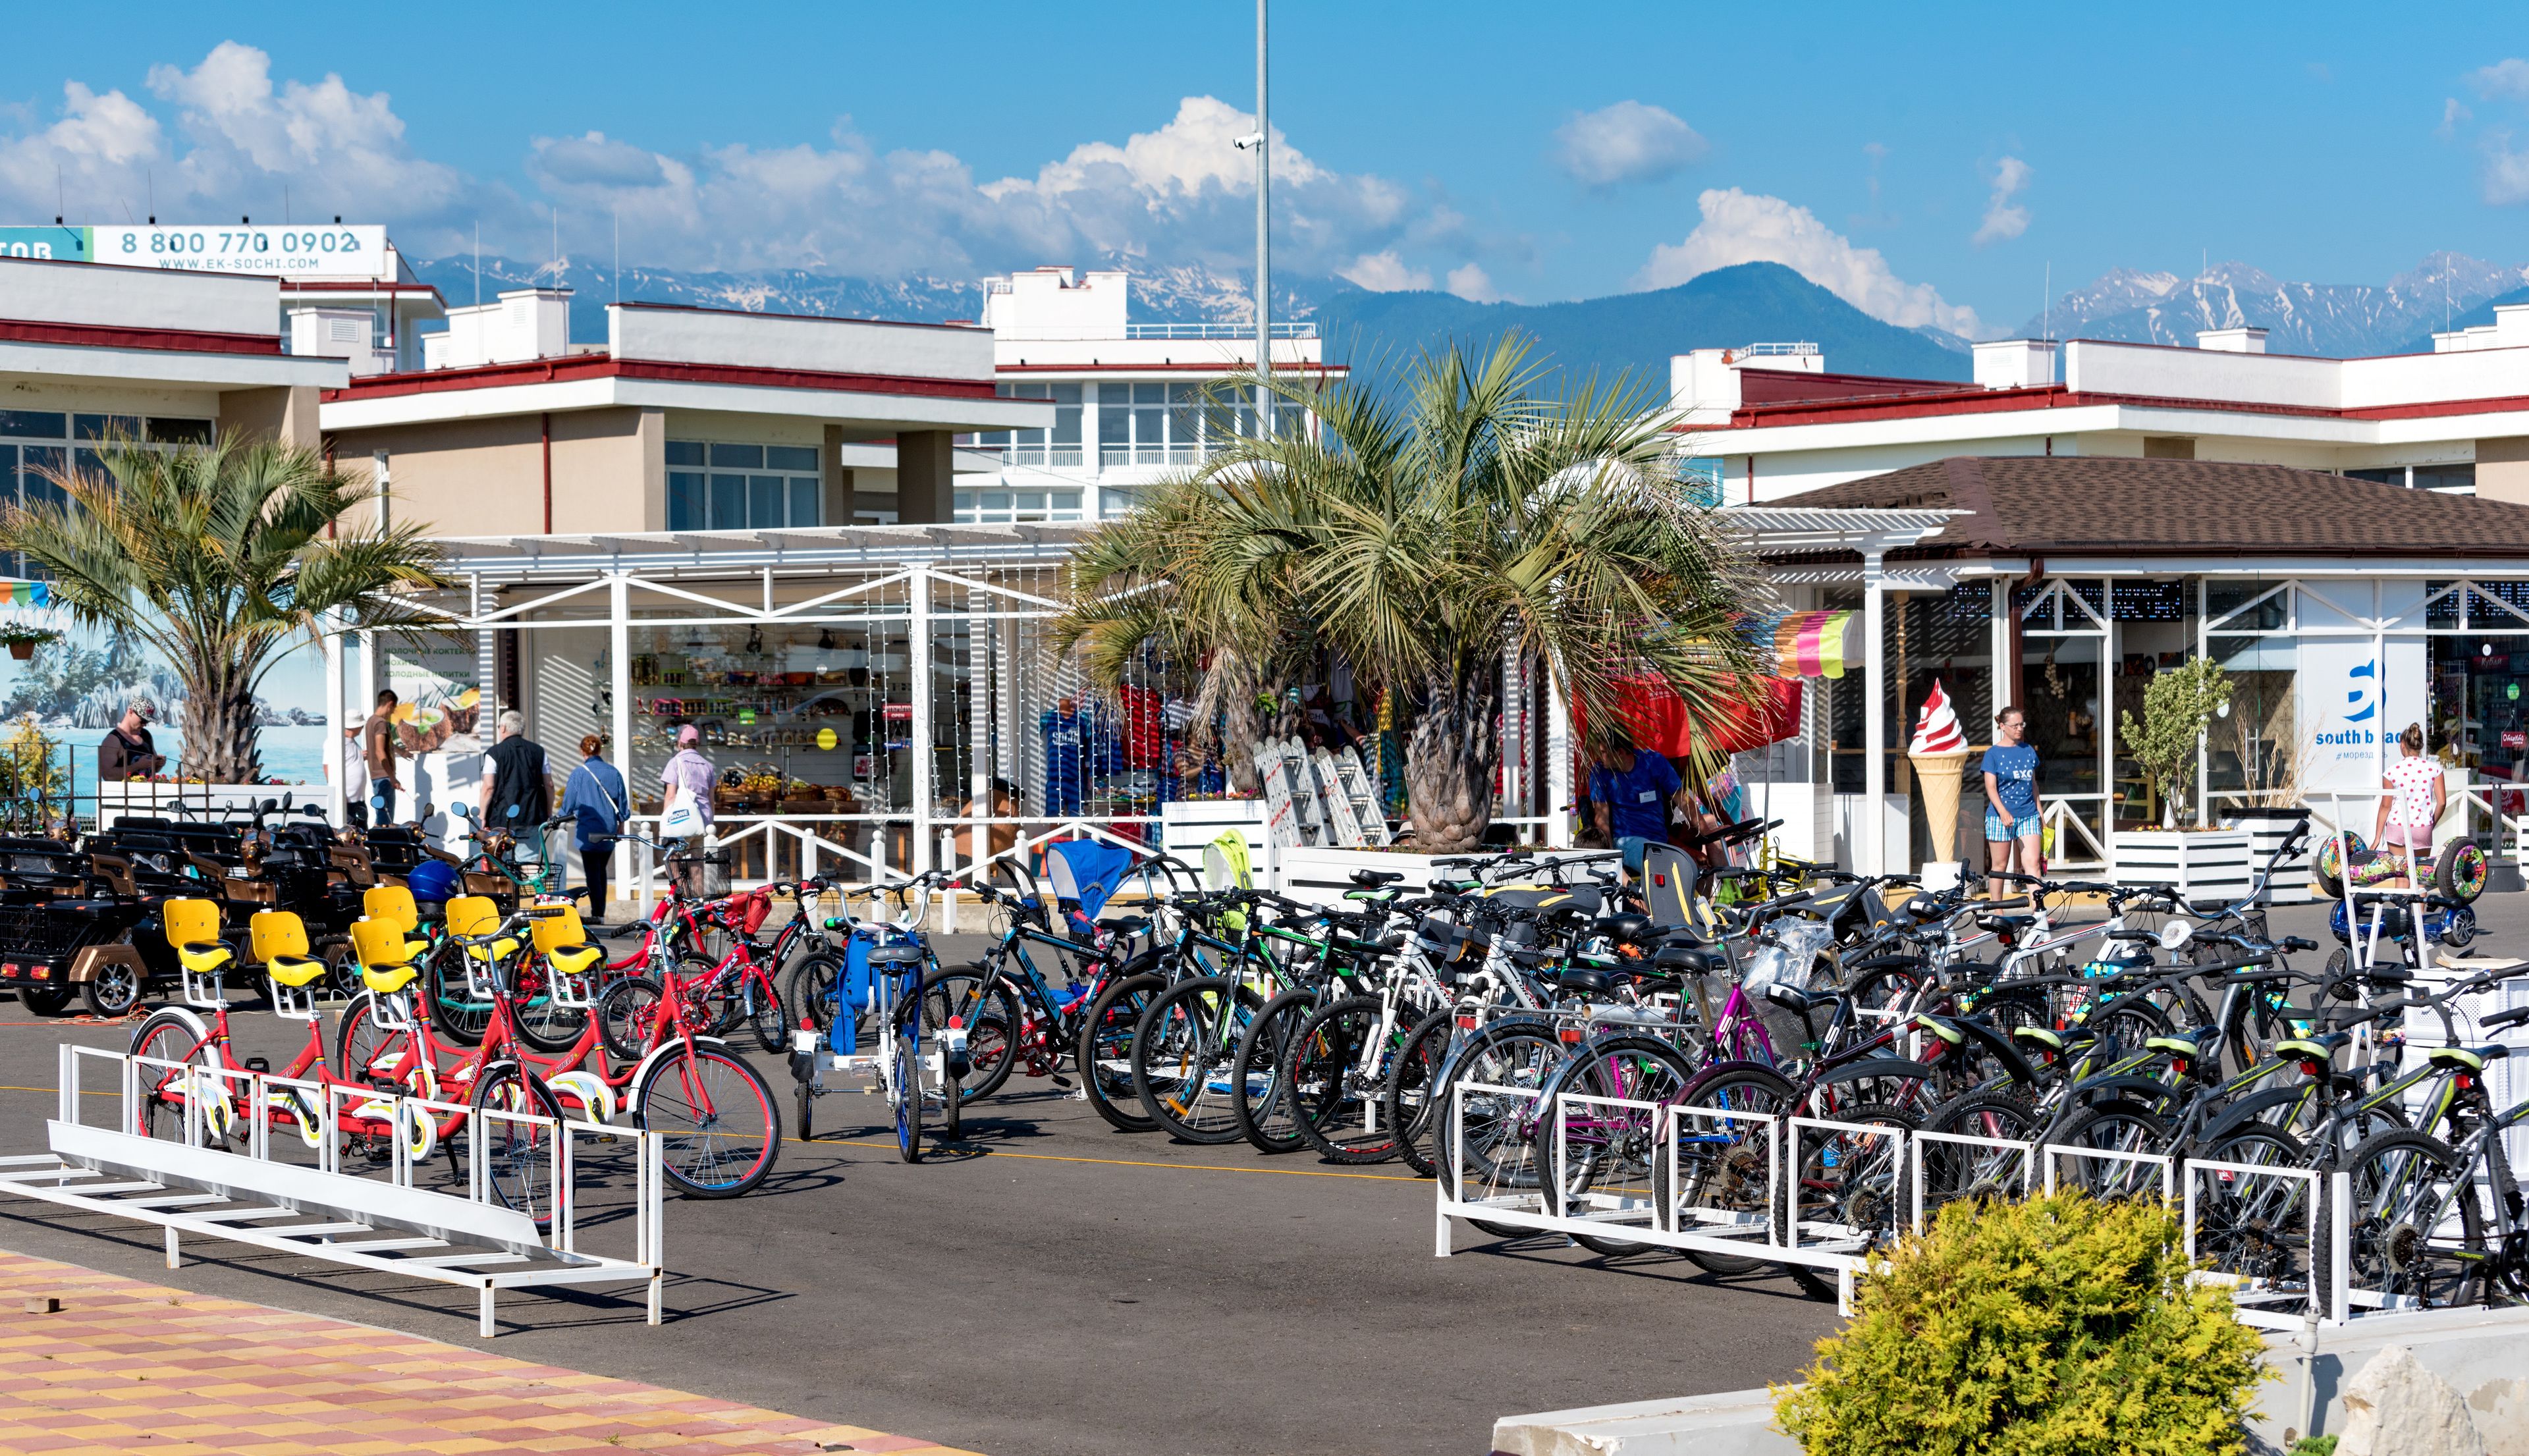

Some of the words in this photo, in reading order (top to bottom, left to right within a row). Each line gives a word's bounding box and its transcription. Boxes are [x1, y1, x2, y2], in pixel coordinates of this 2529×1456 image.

[122, 233, 137, 253] 8
[151, 233, 204, 253] 800
[219, 232, 268, 253] 770
[283, 232, 356, 252] 0902
[159, 258, 319, 269] WWW.EK-SOCHI.COM
[2316, 730, 2361, 745] south
[2365, 730, 2401, 744] bac
[781, 925, 807, 960] STELS
[1921, 929, 1942, 938] Biky
[711, 954, 739, 986] STELS
[1025, 955, 1057, 1010] STELS
[2220, 994, 2238, 1047] STELS
[2115, 1062, 2127, 1071] 2.0
[1984, 1075, 2011, 1091] FLASH
[2219, 1075, 2244, 1092] FLASH
[2246, 1069, 2258, 1079] 2.0
[2353, 1094, 2377, 1110] FLASH
[2379, 1087, 2391, 1097] 2.0
